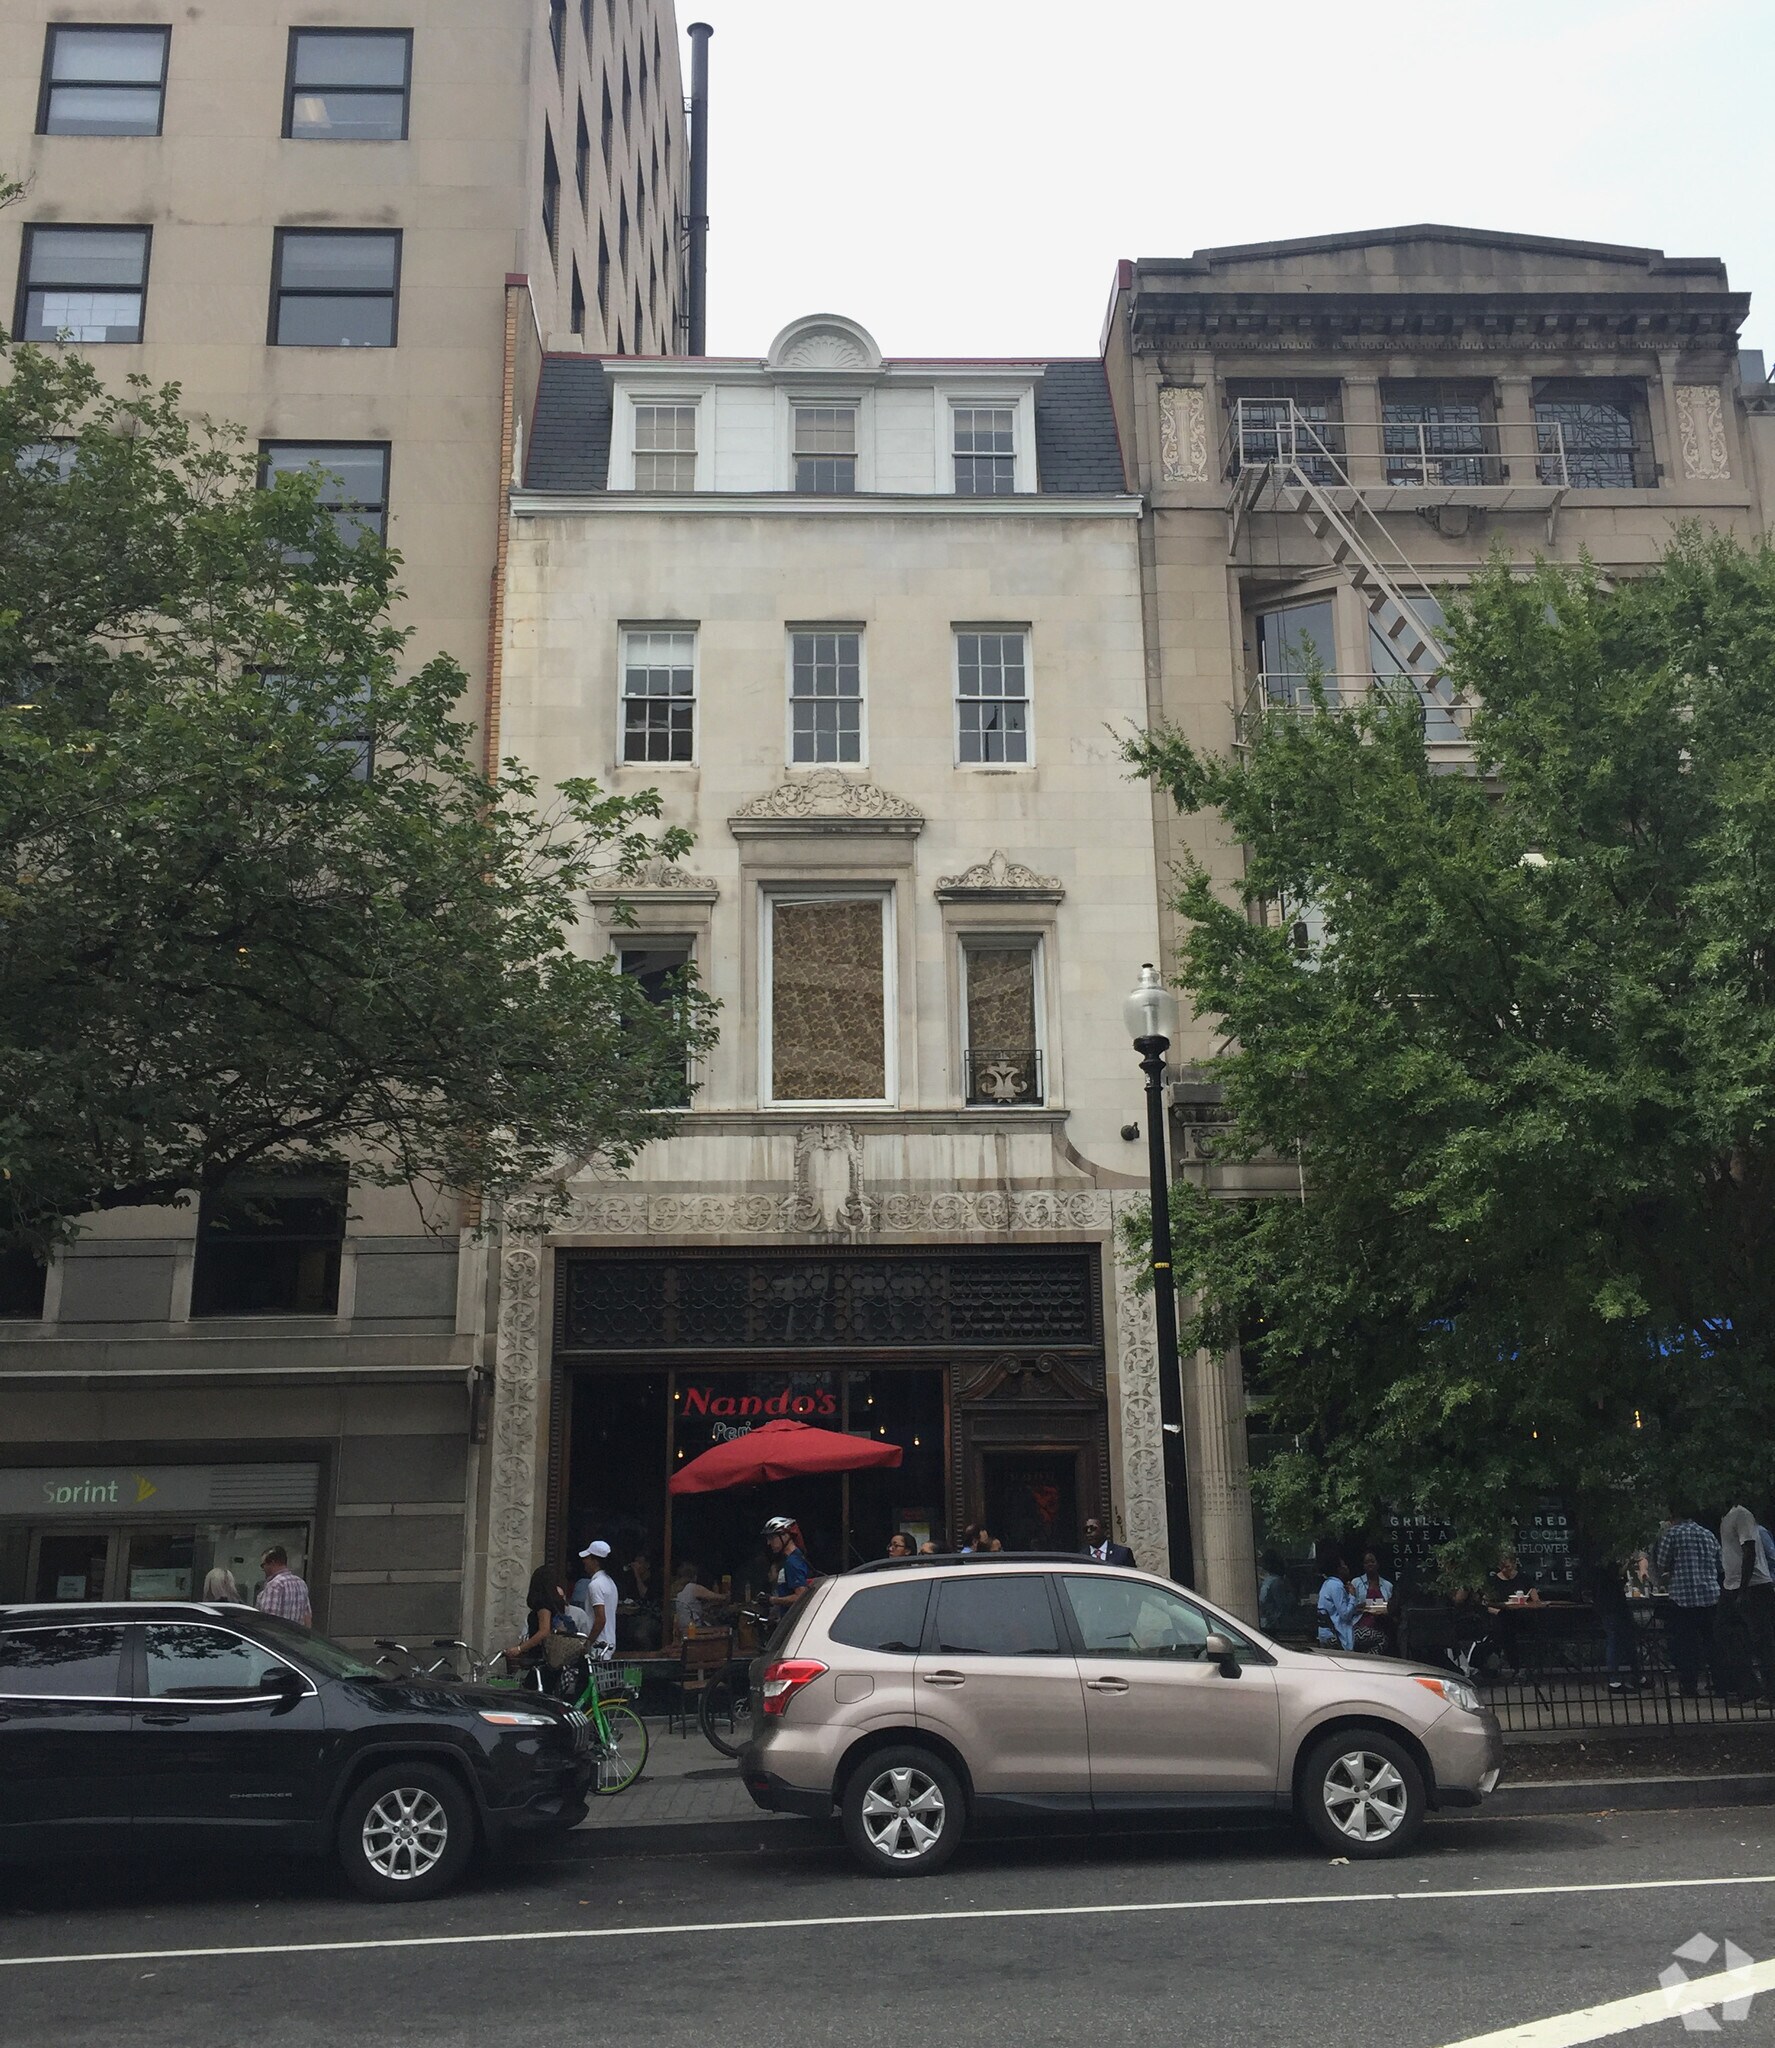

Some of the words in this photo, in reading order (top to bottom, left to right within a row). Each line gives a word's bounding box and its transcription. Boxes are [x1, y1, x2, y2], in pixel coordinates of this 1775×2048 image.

[681, 1387, 837, 1416] Nando's
[43, 1480, 119, 1503] Sprint
[1391, 1530, 1448, 1541] STEA
